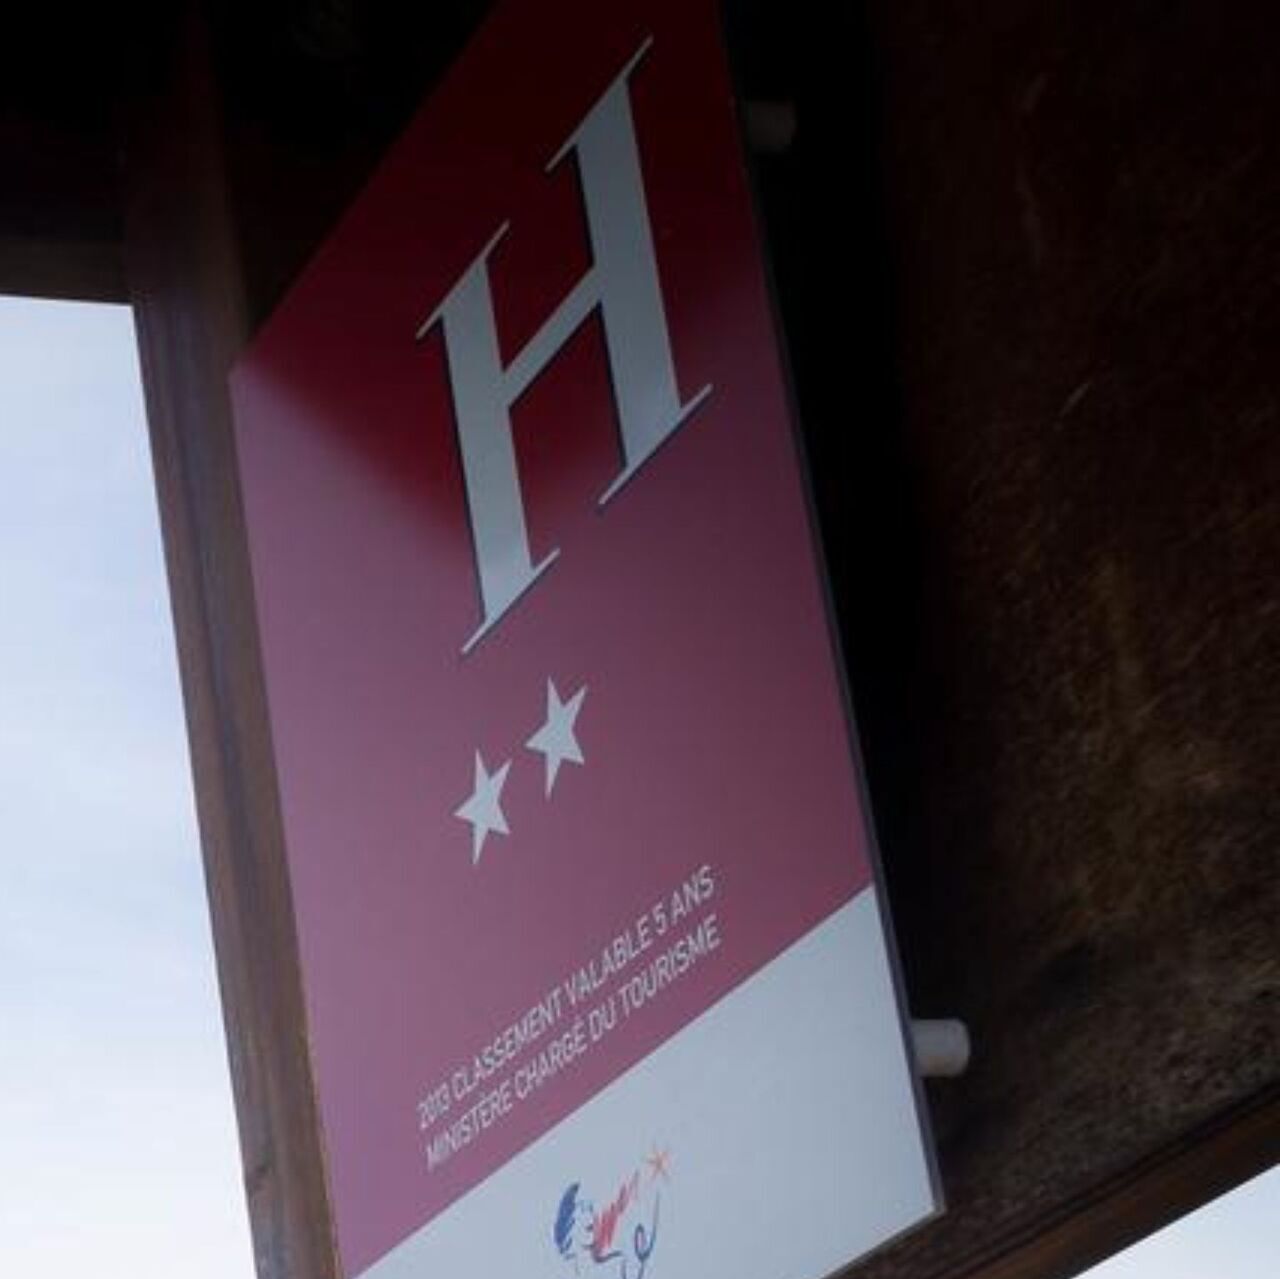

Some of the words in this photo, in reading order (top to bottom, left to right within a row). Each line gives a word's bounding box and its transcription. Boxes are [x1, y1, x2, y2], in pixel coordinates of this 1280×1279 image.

[416, 35, 713, 655] H
[416, 1082, 451, 1130] 2013
[451, 985, 563, 1101] CLASSEMENT
[564, 915, 654, 1007] VALABLE
[652, 902, 667, 936] 5
[670, 864, 716, 924] ANS
[426, 1080, 514, 1173] MINISTÈRE
[589, 998, 618, 1042] DU
[618, 913, 723, 1019] TOURISME
